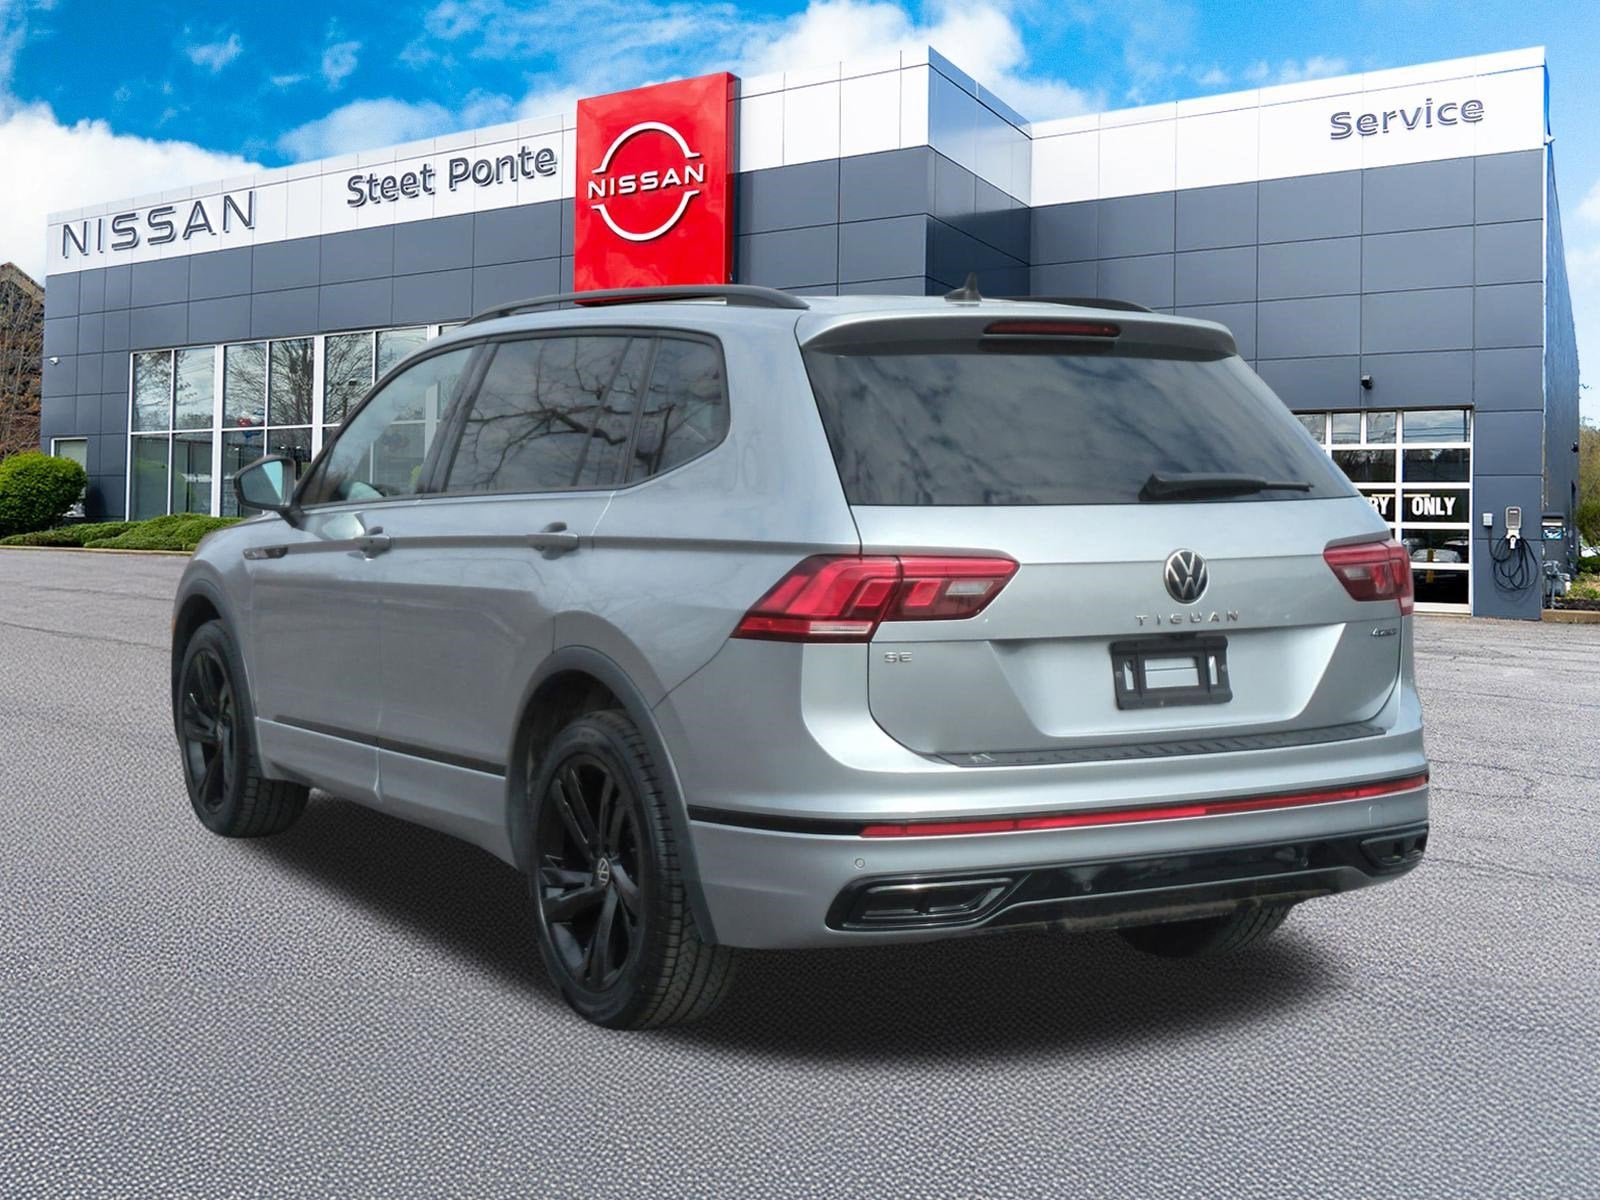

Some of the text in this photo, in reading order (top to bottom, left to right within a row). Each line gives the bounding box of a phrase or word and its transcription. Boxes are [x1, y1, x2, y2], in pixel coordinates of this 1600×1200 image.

[1330, 98, 1484, 140] Service
[347, 146, 557, 207] Steet Ponte
[587, 163, 705, 200] NISSAN
[62, 190, 255, 259] NISSAN
[1411, 496, 1456, 516] ONLY
[1135, 609, 1239, 626] TIGUAN
[884, 651, 912, 663] SE
